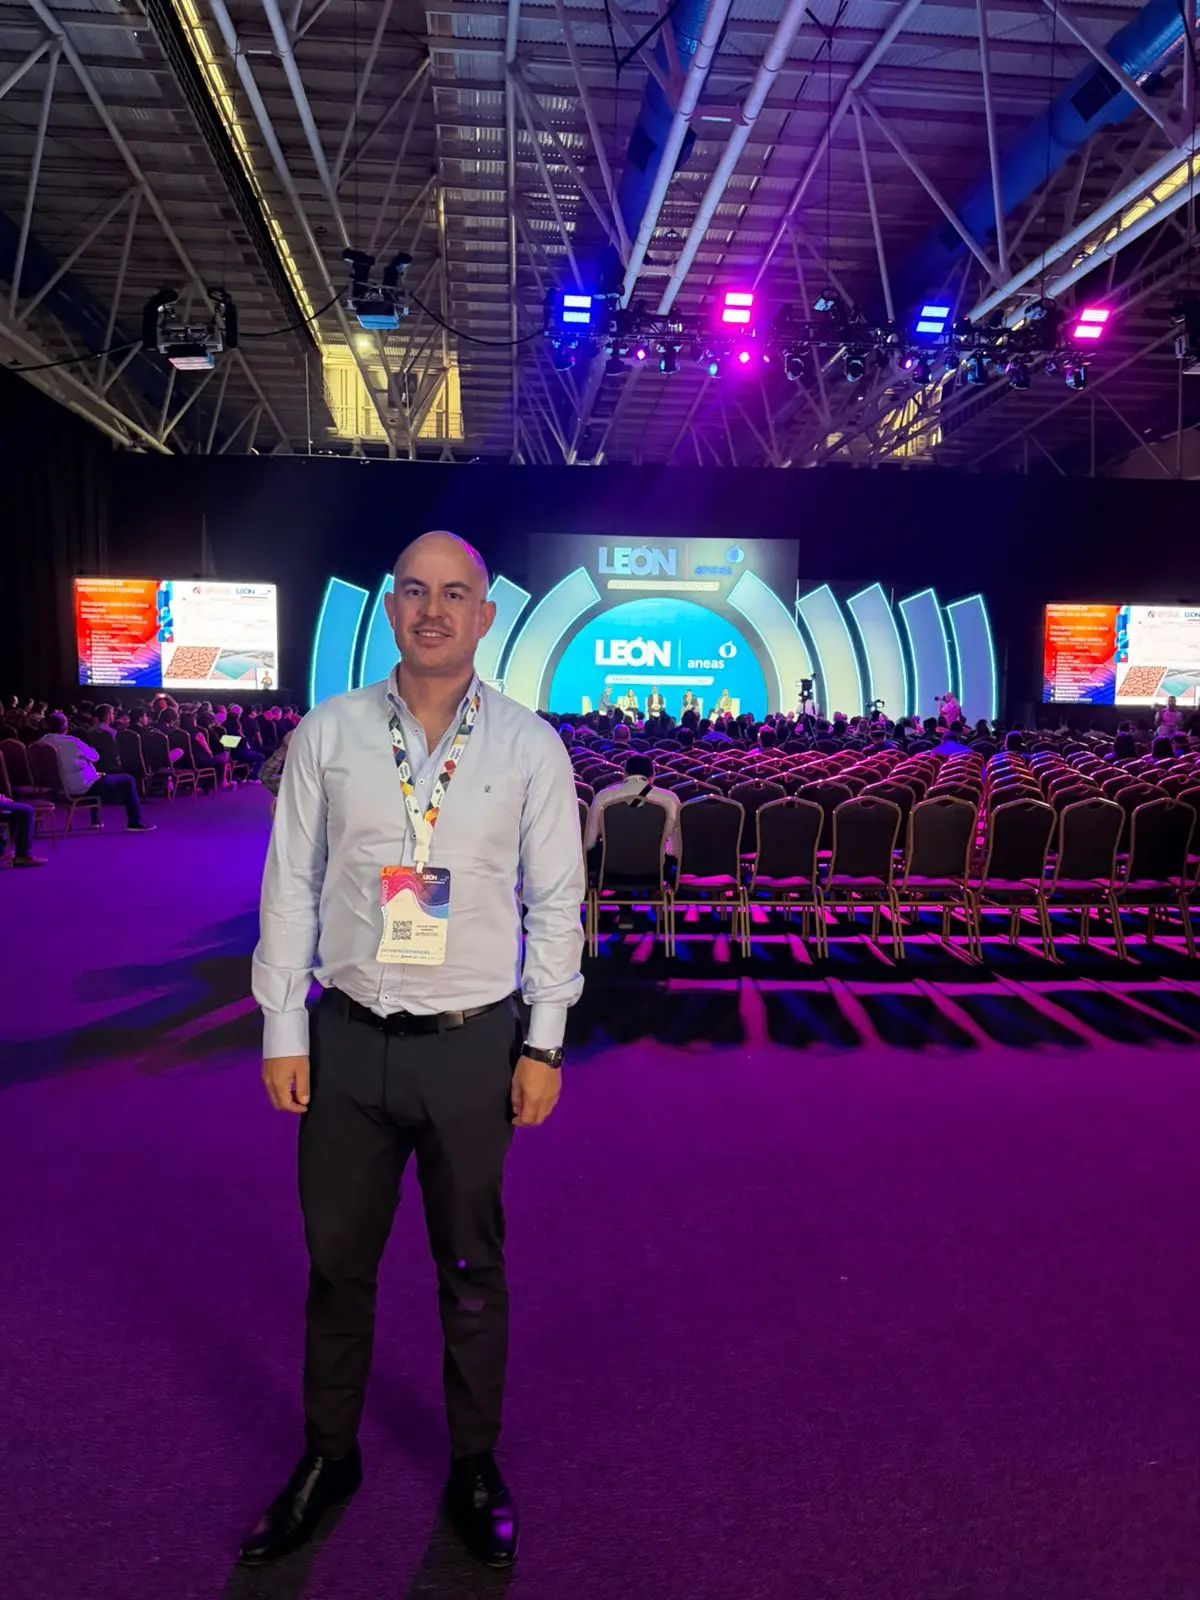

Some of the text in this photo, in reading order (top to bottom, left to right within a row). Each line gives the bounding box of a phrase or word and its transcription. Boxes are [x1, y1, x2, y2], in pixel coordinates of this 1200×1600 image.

[598, 544, 677, 576] LEÓN
[595, 636, 671, 668] LEÓN
[687, 658, 725, 670] aneas
